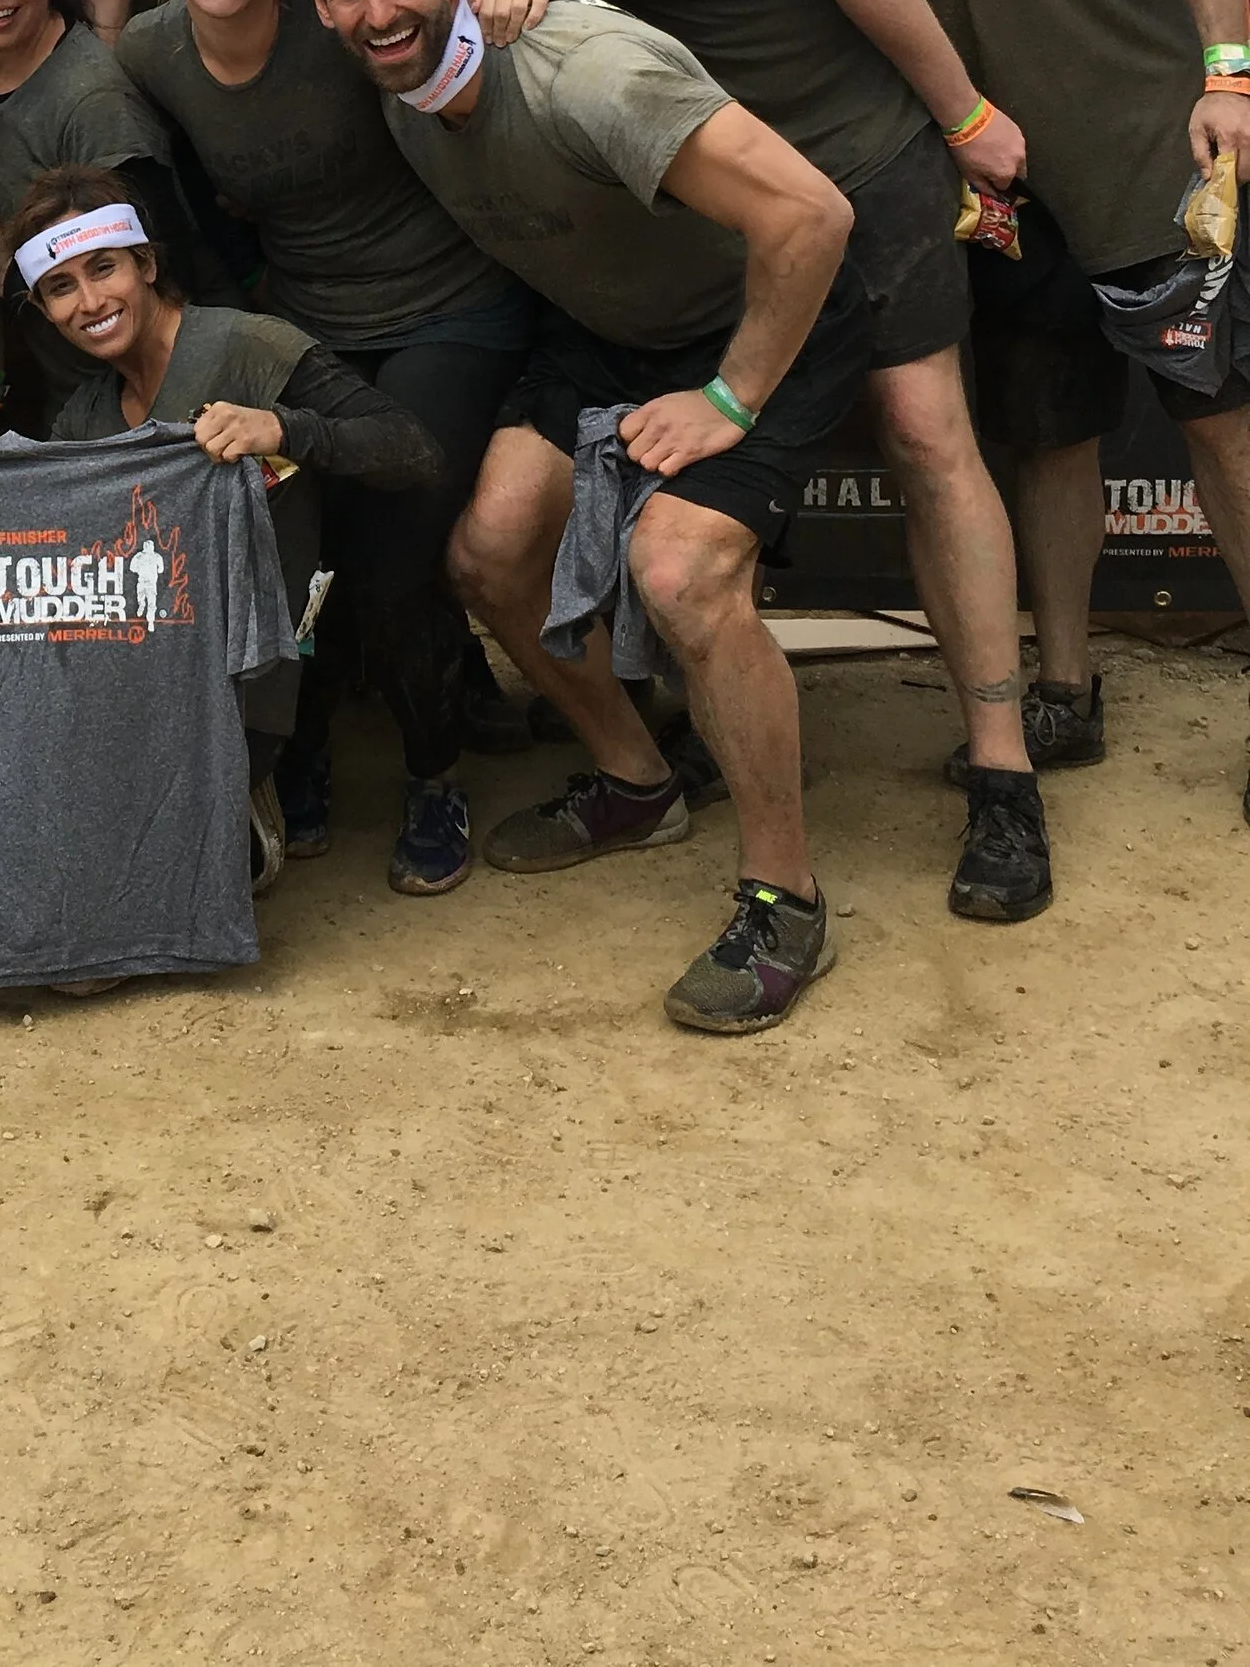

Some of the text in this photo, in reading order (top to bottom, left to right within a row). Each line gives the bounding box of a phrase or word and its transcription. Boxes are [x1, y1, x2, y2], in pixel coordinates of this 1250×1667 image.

[429, 43, 468, 104] MUDDER HALF
[54, 238, 75, 254] HALF
[1105, 514, 1213, 535] MUDDE
[35, 633, 45, 642] BY
[48, 629, 129, 642] MERRELL
